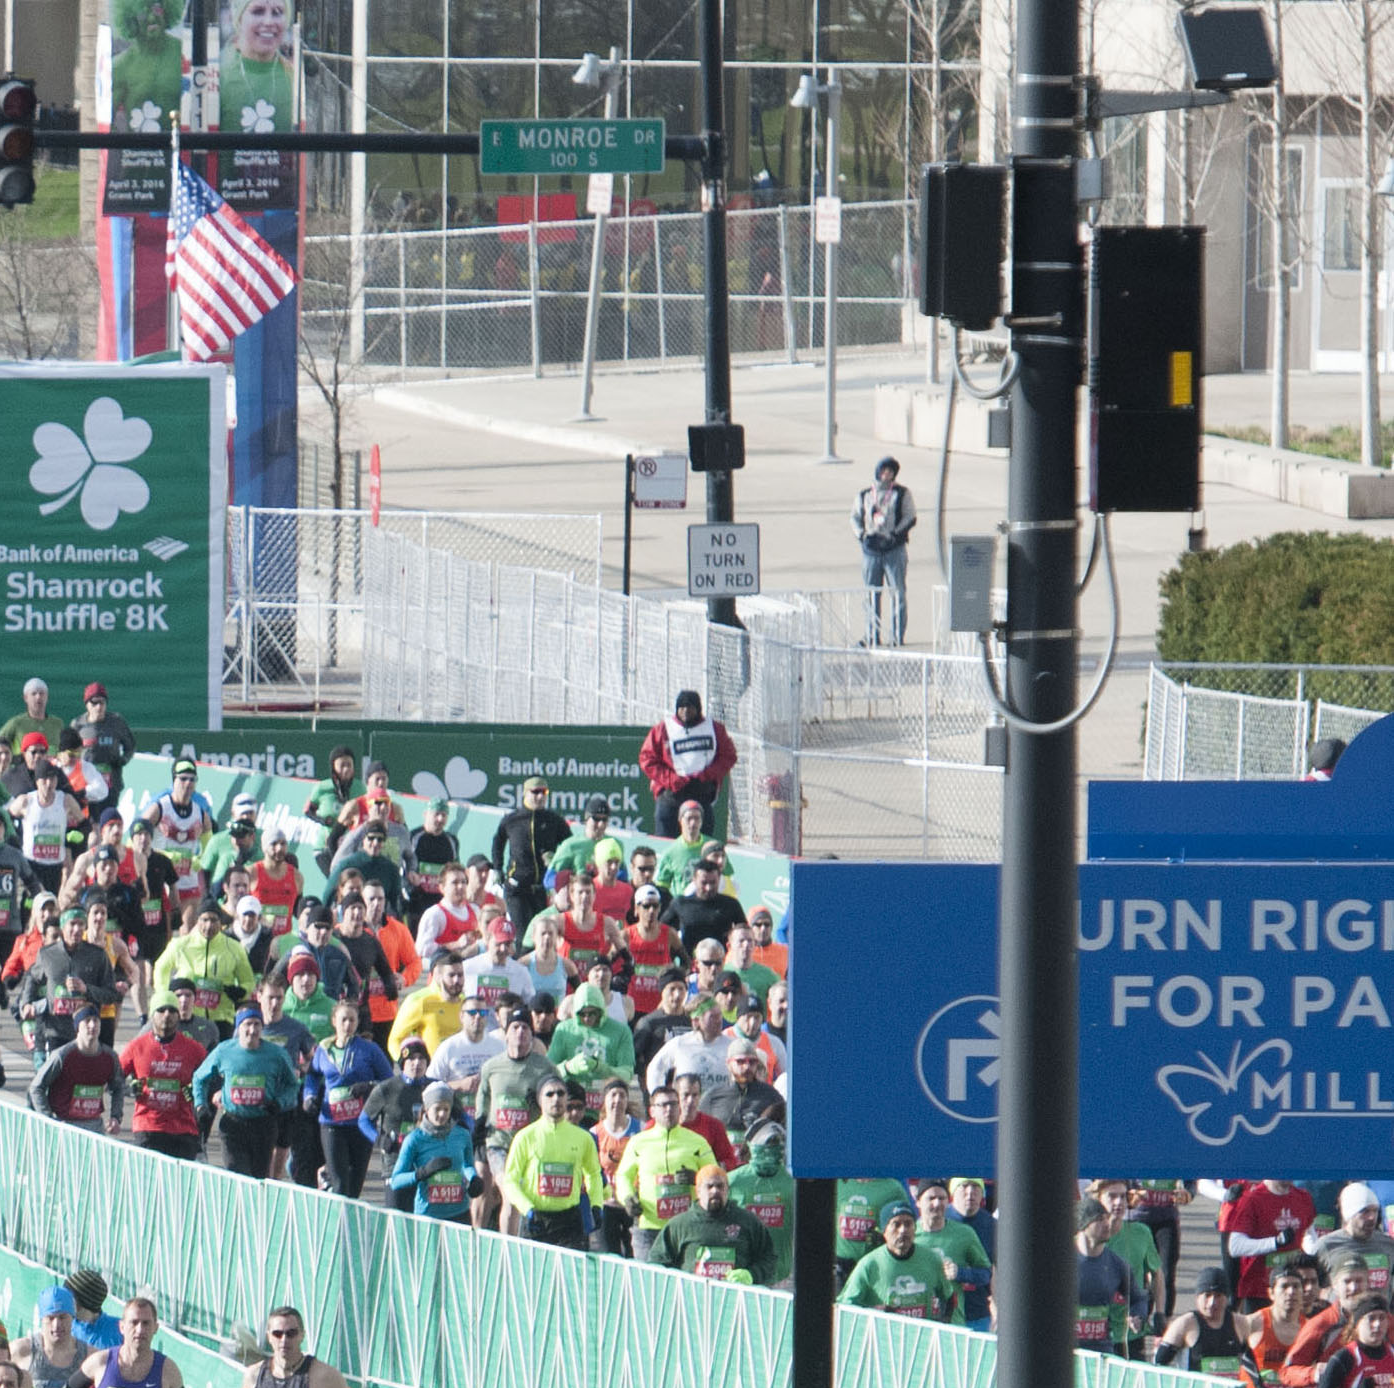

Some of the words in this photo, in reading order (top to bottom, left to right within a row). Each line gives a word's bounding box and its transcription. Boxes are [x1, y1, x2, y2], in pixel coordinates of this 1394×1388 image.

[518, 127, 618, 149] MONROE
[635, 129, 656, 146] DR
[550, 153, 578, 169] 100
[587, 153, 599, 169] S
[108, 179, 131, 192] April
[134, 179, 142, 191] 3,
[145, 179, 165, 190] 2016
[221, 178, 245, 192] April
[247, 178, 256, 190] 3,
[258, 178, 279, 189] 2016
[108, 190, 131, 201] Grant
[135, 190, 154, 201] Park
[221, 190, 245, 201] Grant
[248, 190, 269, 201] Park
[711, 532, 737, 548] NO
[44, 545, 62, 564] of
[63, 545, 139, 564] America
[704, 553, 746, 569] TURN
[5, 570, 163, 600] Shamrock
[694, 573, 718, 590] ON
[723, 573, 755, 589] RED
[4, 602, 116, 633] Shuffle
[125, 604, 168, 633] 8K
[498, 757, 545, 776] Bank
[546, 757, 564, 776] of
[565, 757, 640, 779] America
[1077, 899, 1222, 951] URN
[1252, 899, 1394, 951] RIG
[1112, 975, 1266, 1028] FOR
